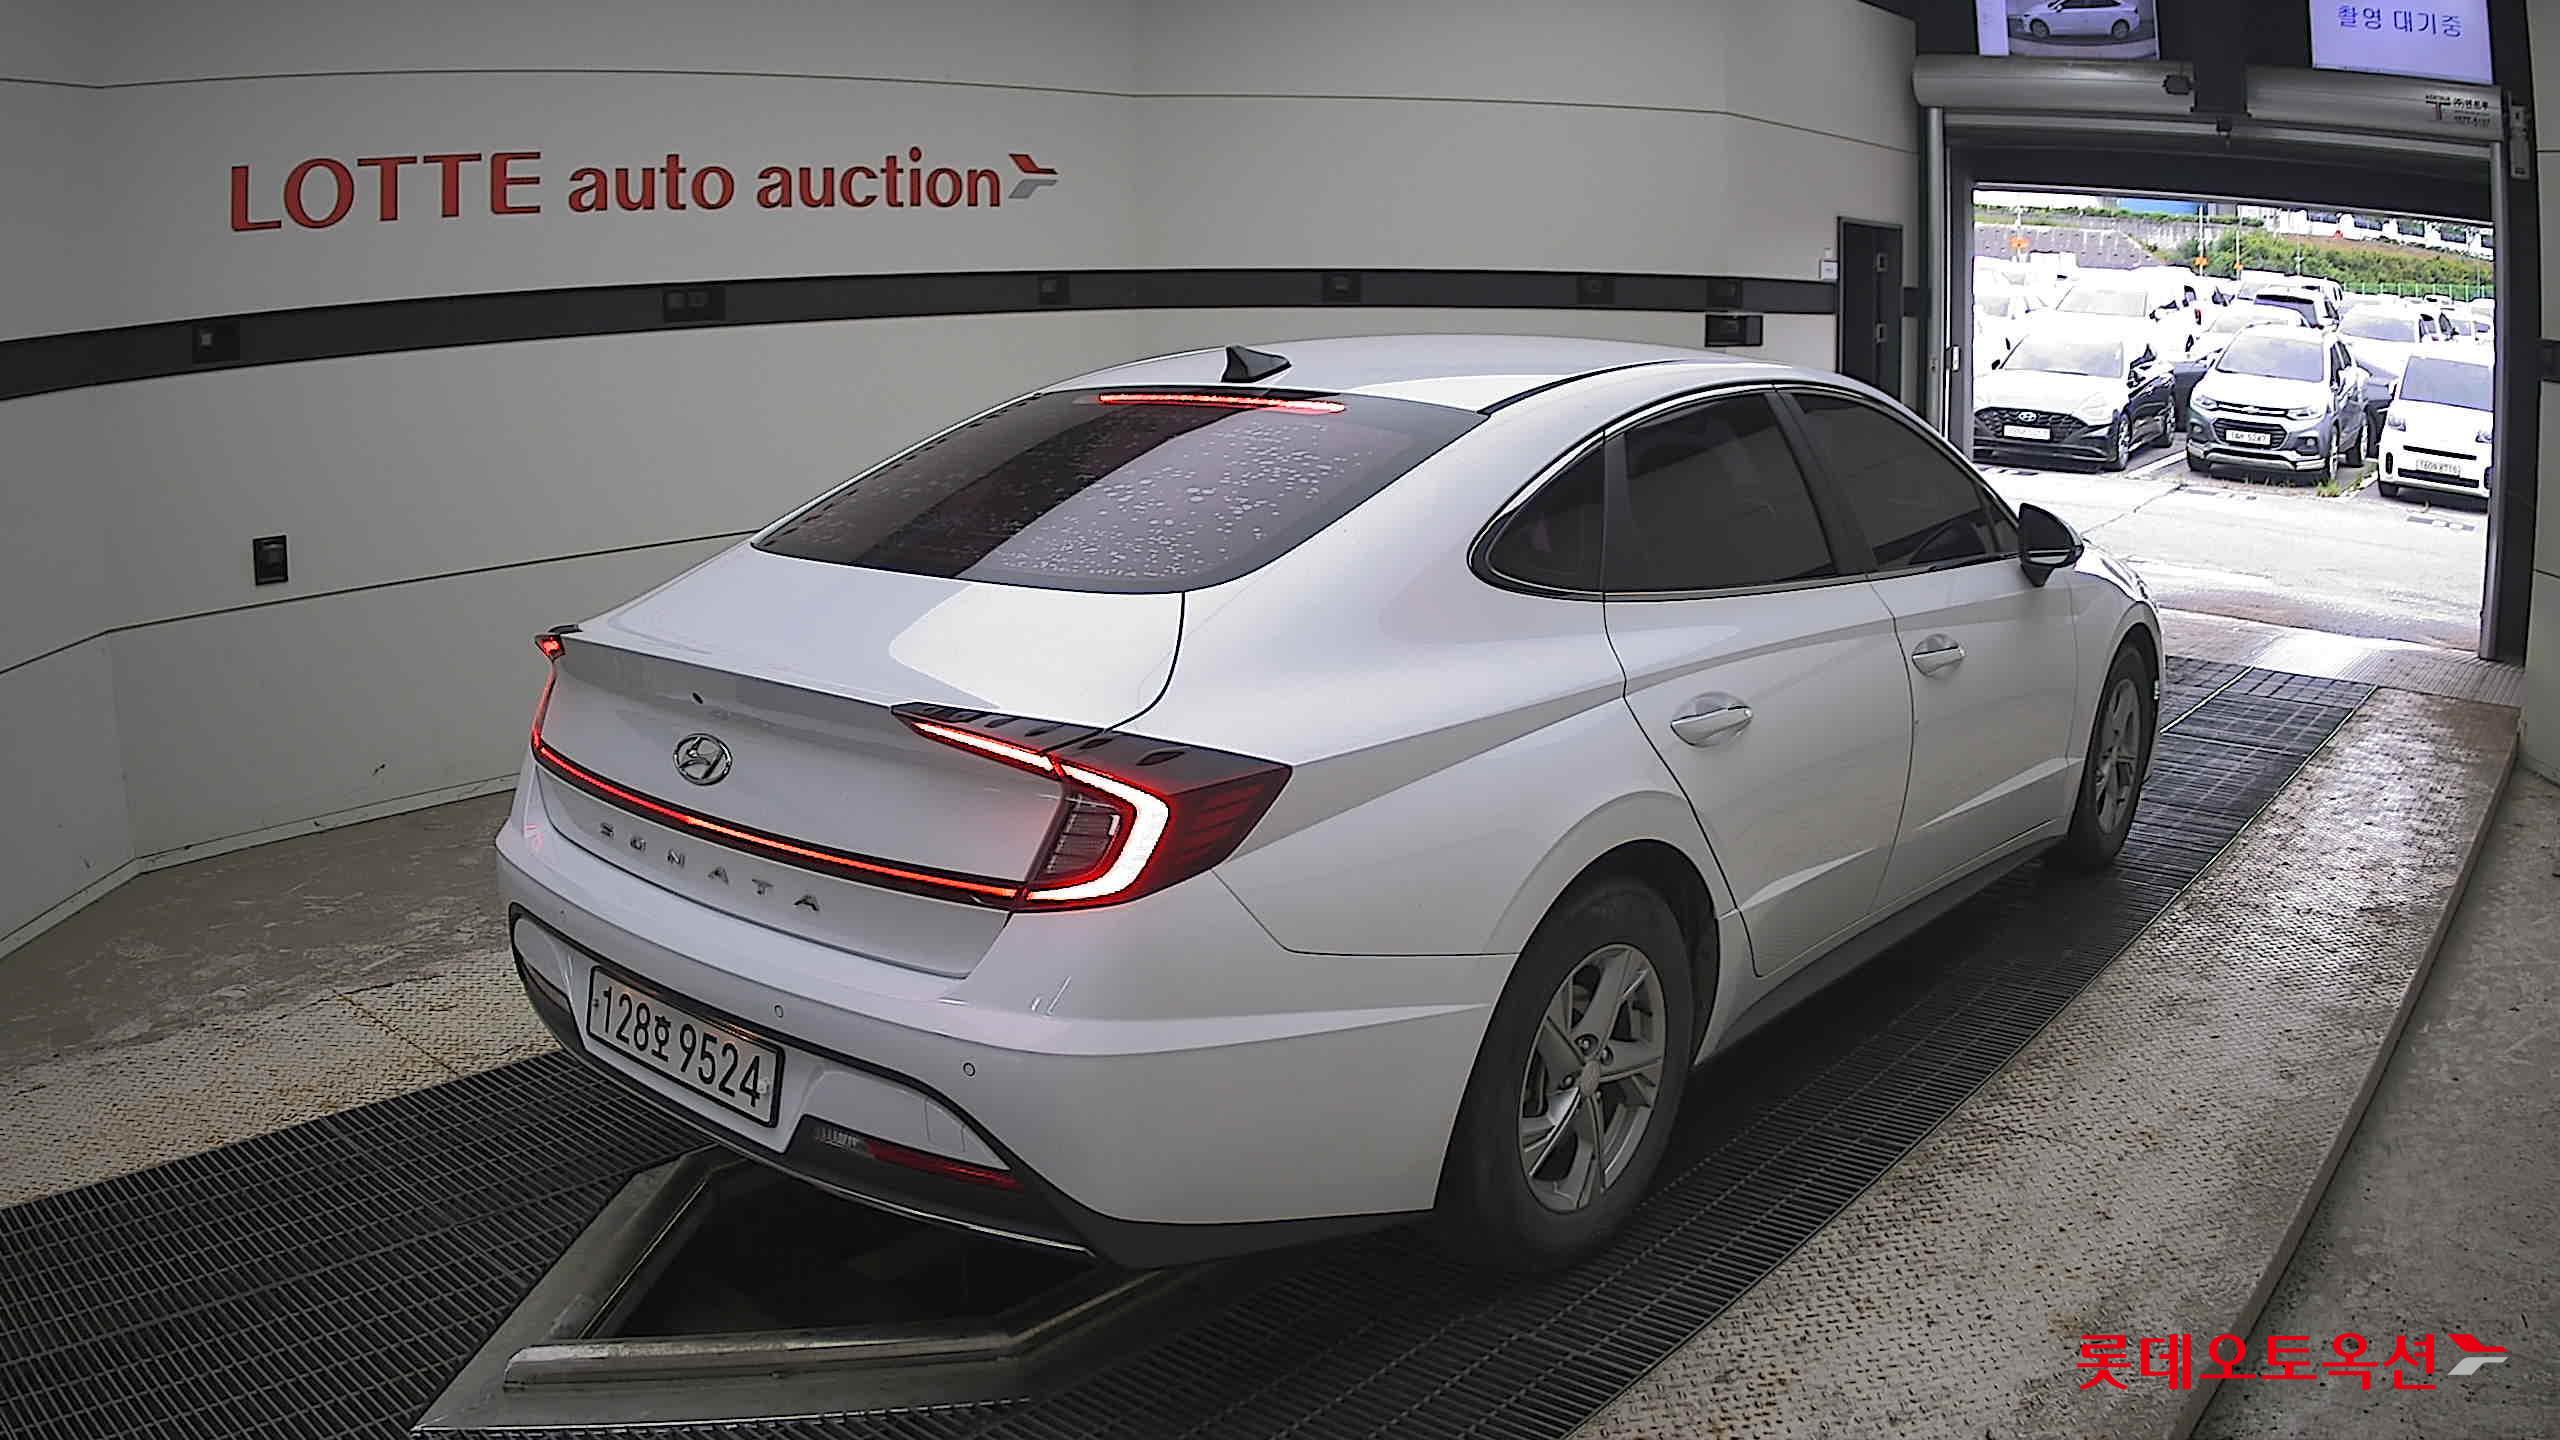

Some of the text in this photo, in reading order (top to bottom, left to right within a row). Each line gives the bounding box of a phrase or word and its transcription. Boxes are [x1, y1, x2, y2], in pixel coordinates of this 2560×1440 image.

[2338, 5, 2463, 38] 촬영 대기중
[230, 146, 1002, 232] LOTTE auto auction
[600, 821, 821, 912] SONATA
[679, 1023, 761, 1108] 9524
